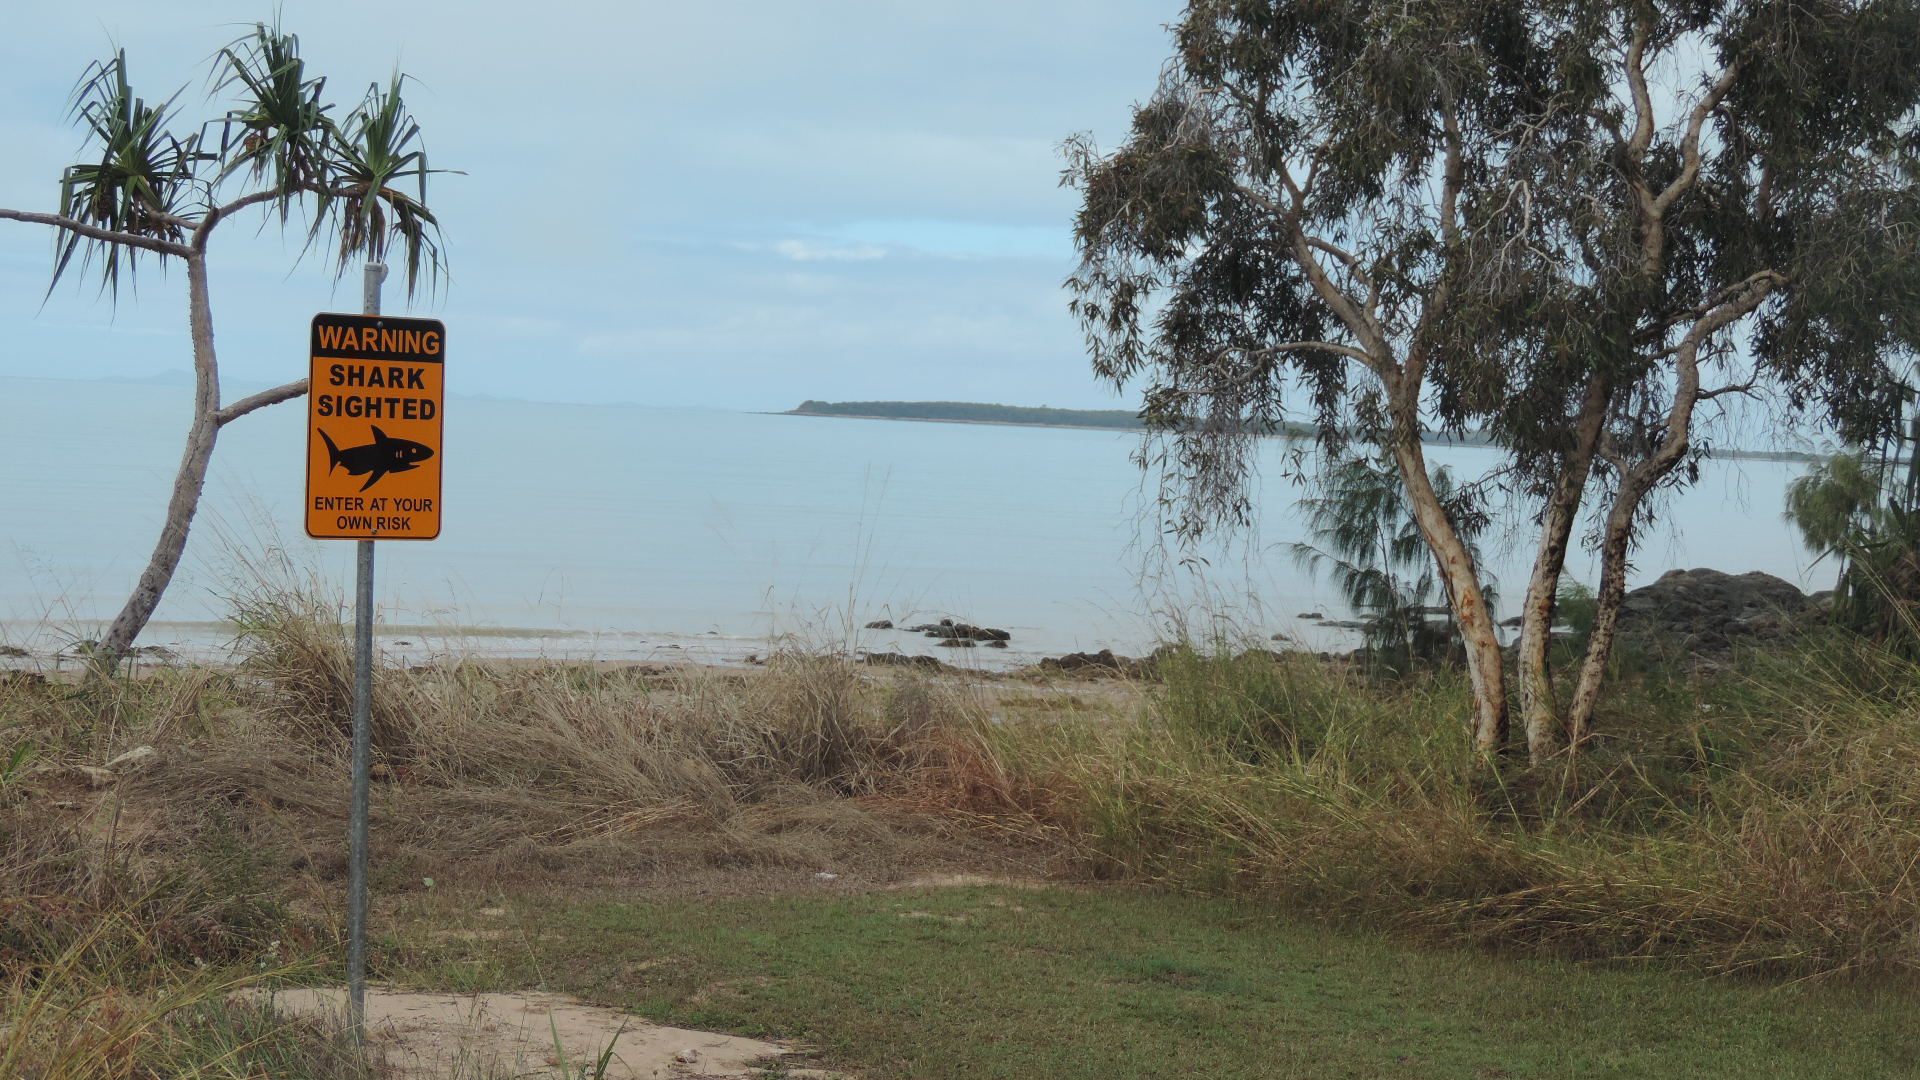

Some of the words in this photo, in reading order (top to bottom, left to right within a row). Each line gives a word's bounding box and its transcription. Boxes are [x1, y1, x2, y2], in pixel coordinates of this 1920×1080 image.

[318, 325, 440, 355] WARNING
[329, 364, 425, 389] SHARK
[317, 395, 436, 420] SIGHTED
[314, 496, 364, 511] ENTER
[369, 497, 388, 511] AT
[393, 498, 432, 512] YOUR
[336, 516, 372, 530] OWN
[376, 517, 411, 530] RISK
